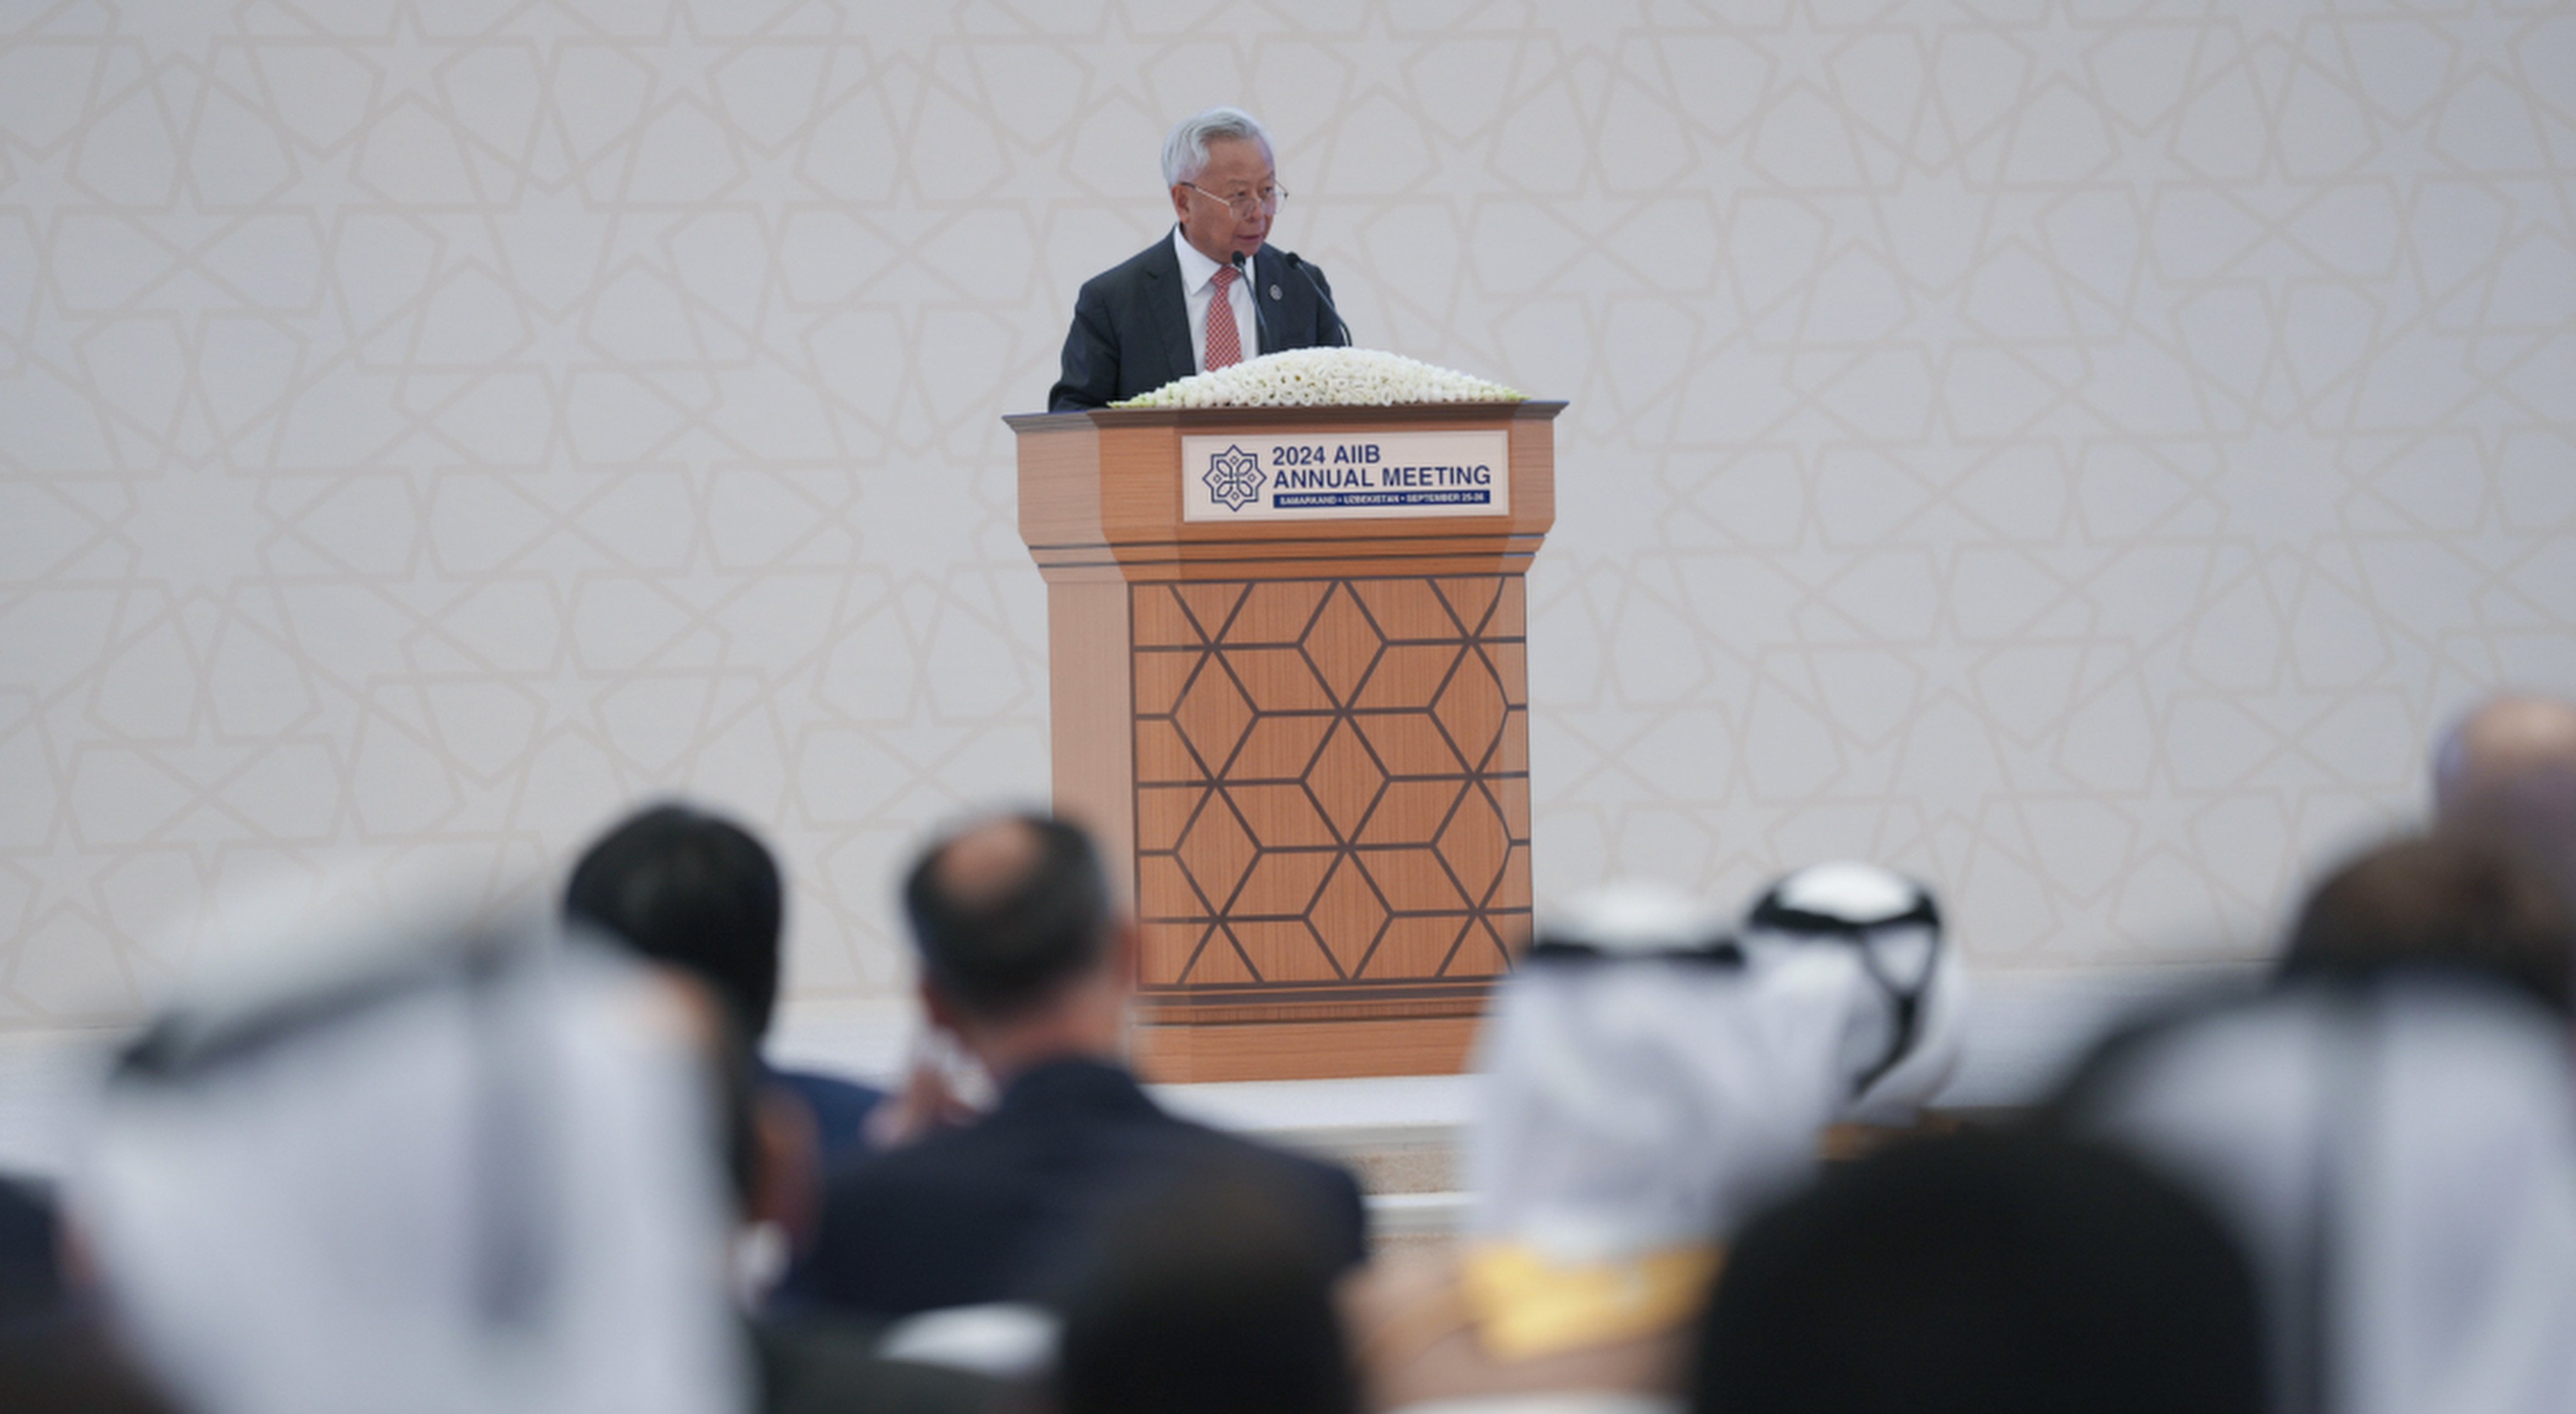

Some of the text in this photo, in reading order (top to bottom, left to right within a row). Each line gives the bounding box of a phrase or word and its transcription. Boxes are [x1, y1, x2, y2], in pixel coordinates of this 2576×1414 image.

[1273, 445, 1381, 465] 2024 AIIB
[1273, 465, 1491, 488] ANNUAL MEETING
[1280, 496, 1337, 505] SAMARKAND
[1344, 494, 1400, 504] UZBEKISTAN
[1407, 493, 1460, 503] SEPTEMBER
